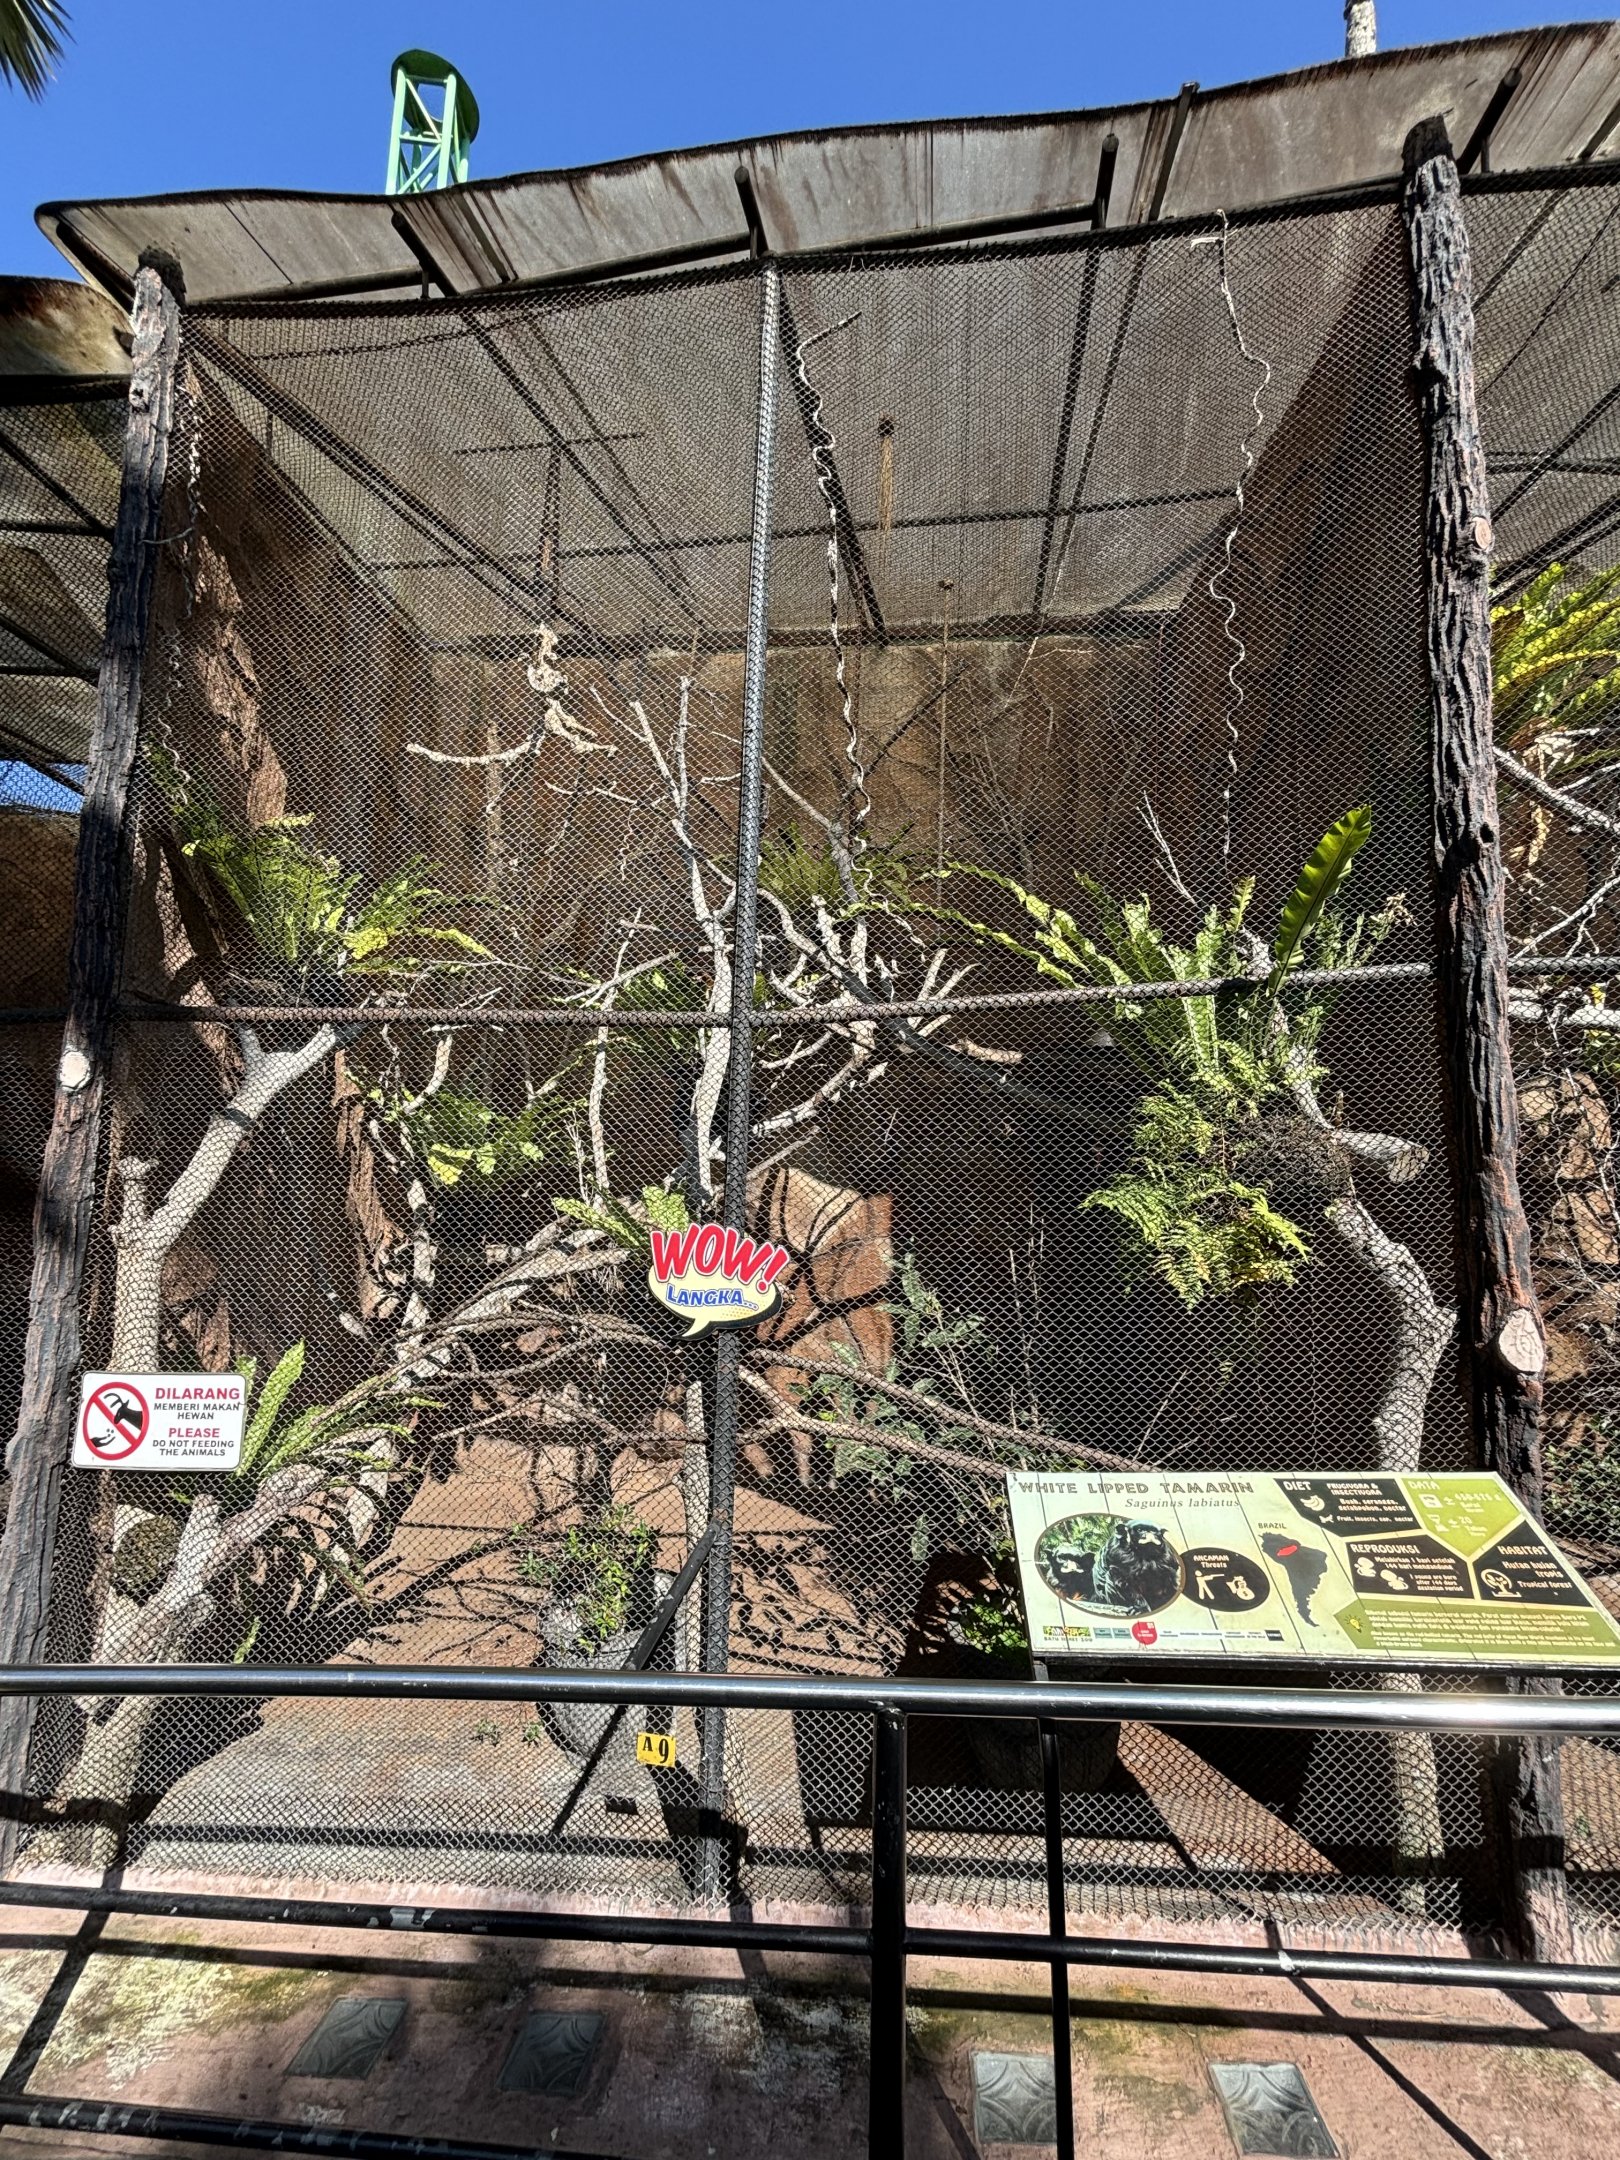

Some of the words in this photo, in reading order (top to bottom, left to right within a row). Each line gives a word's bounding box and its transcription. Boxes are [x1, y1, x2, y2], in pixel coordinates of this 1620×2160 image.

[651, 1223, 789, 1293] WOW!
[667, 1284, 759, 1310] LANGKA...
[155, 1388, 240, 1400] DILARANG
[154, 1403, 200, 1411] MEMBERI
[203, 1403, 240, 1411] MAKAN
[177, 1412, 214, 1420] HEWAN
[168, 1428, 220, 1438] PLEASE
[169, 1440, 190, 1448] NOT
[192, 1440, 234, 1448] FEEDING
[1018, 1482, 1078, 1494] WHITE
[1087, 1482, 1149, 1494] LIPPED
[1160, 1482, 1254, 1493] TAMARIN
[1283, 1481, 1311, 1490] DIET
[1407, 1480, 1440, 1490] DATA
[1125, 1498, 1183, 1509] Saguinus
[1188, 1498, 1240, 1508] labiatus
[1258, 1522, 1287, 1530] BRAZIL
[1350, 1543, 1420, 1554] REPRODUKSI
[1497, 1545, 1549, 1555] HABITAT
[1501, 1561, 1531, 1569] Hutan
[1549, 1581, 1573, 1589] forest
